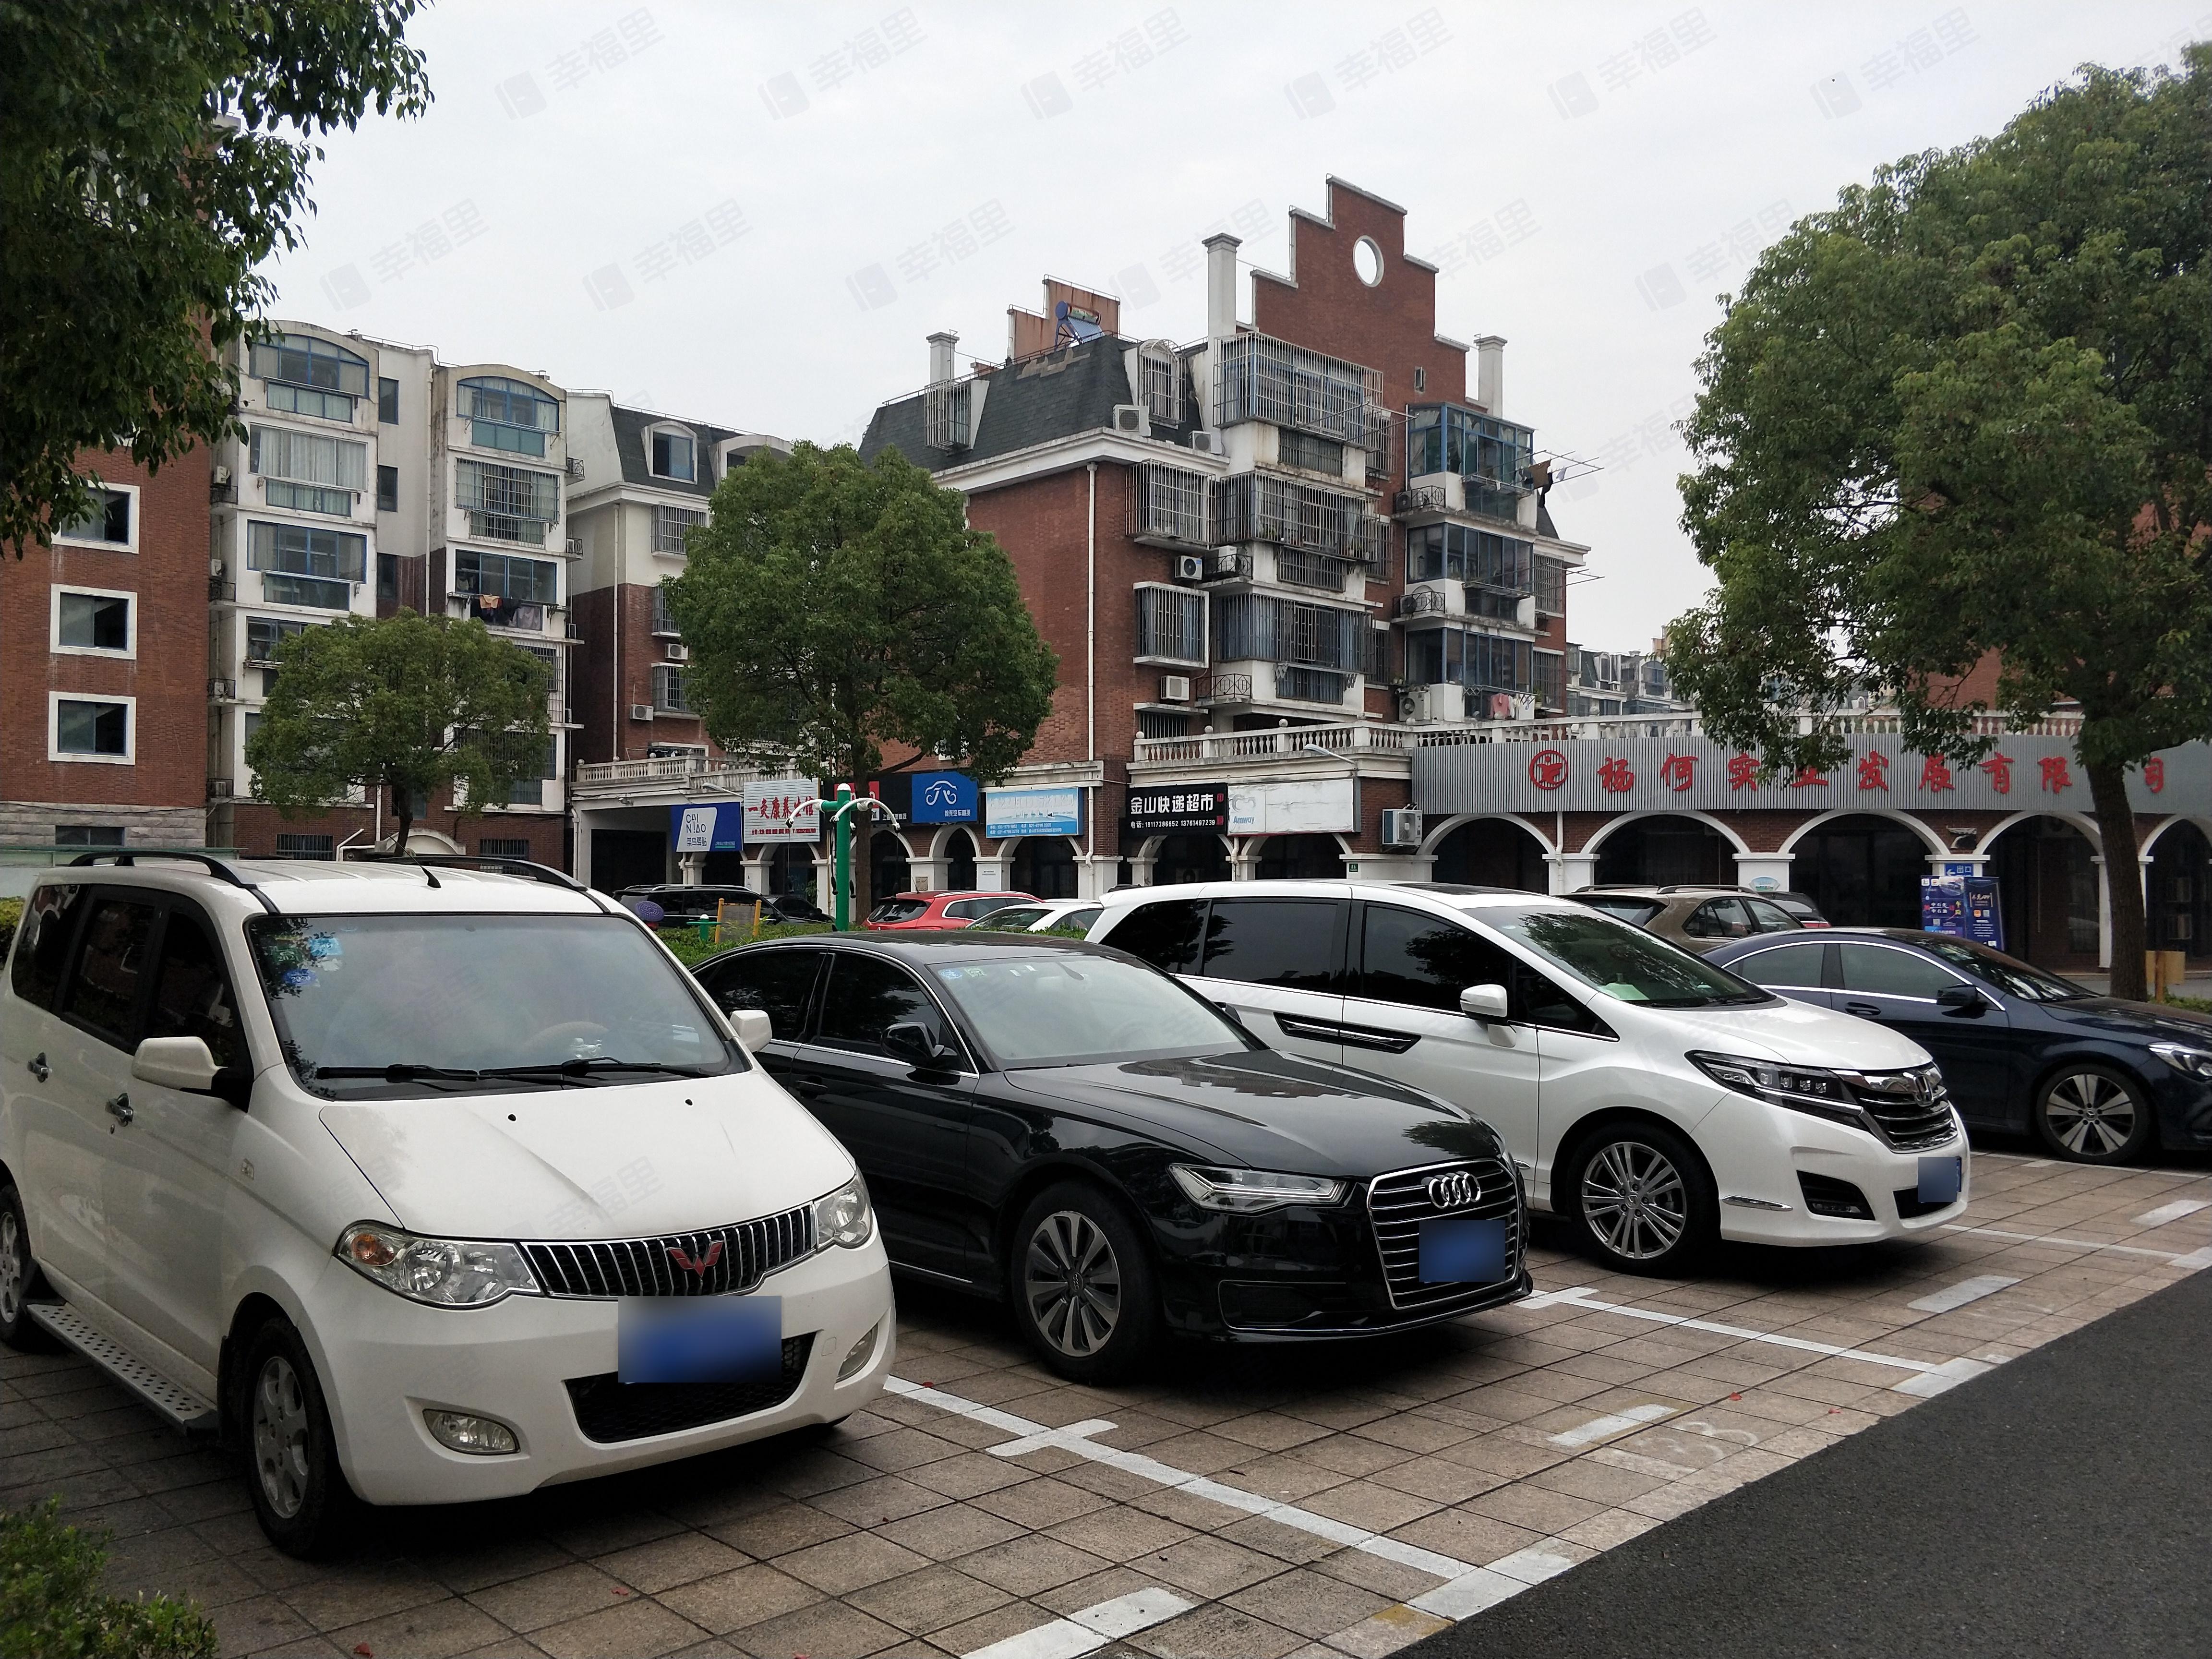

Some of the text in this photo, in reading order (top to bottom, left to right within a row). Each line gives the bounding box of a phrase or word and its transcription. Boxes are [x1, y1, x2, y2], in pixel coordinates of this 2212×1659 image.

[1597, 751, 2164, 794] 杨何实业发展有限司
[1130, 793, 1214, 815] 金山快递超市
[686, 813, 699, 823] CAI
[1233, 816, 1255, 825] Amway
[1957, 865, 1972, 874] 出口
